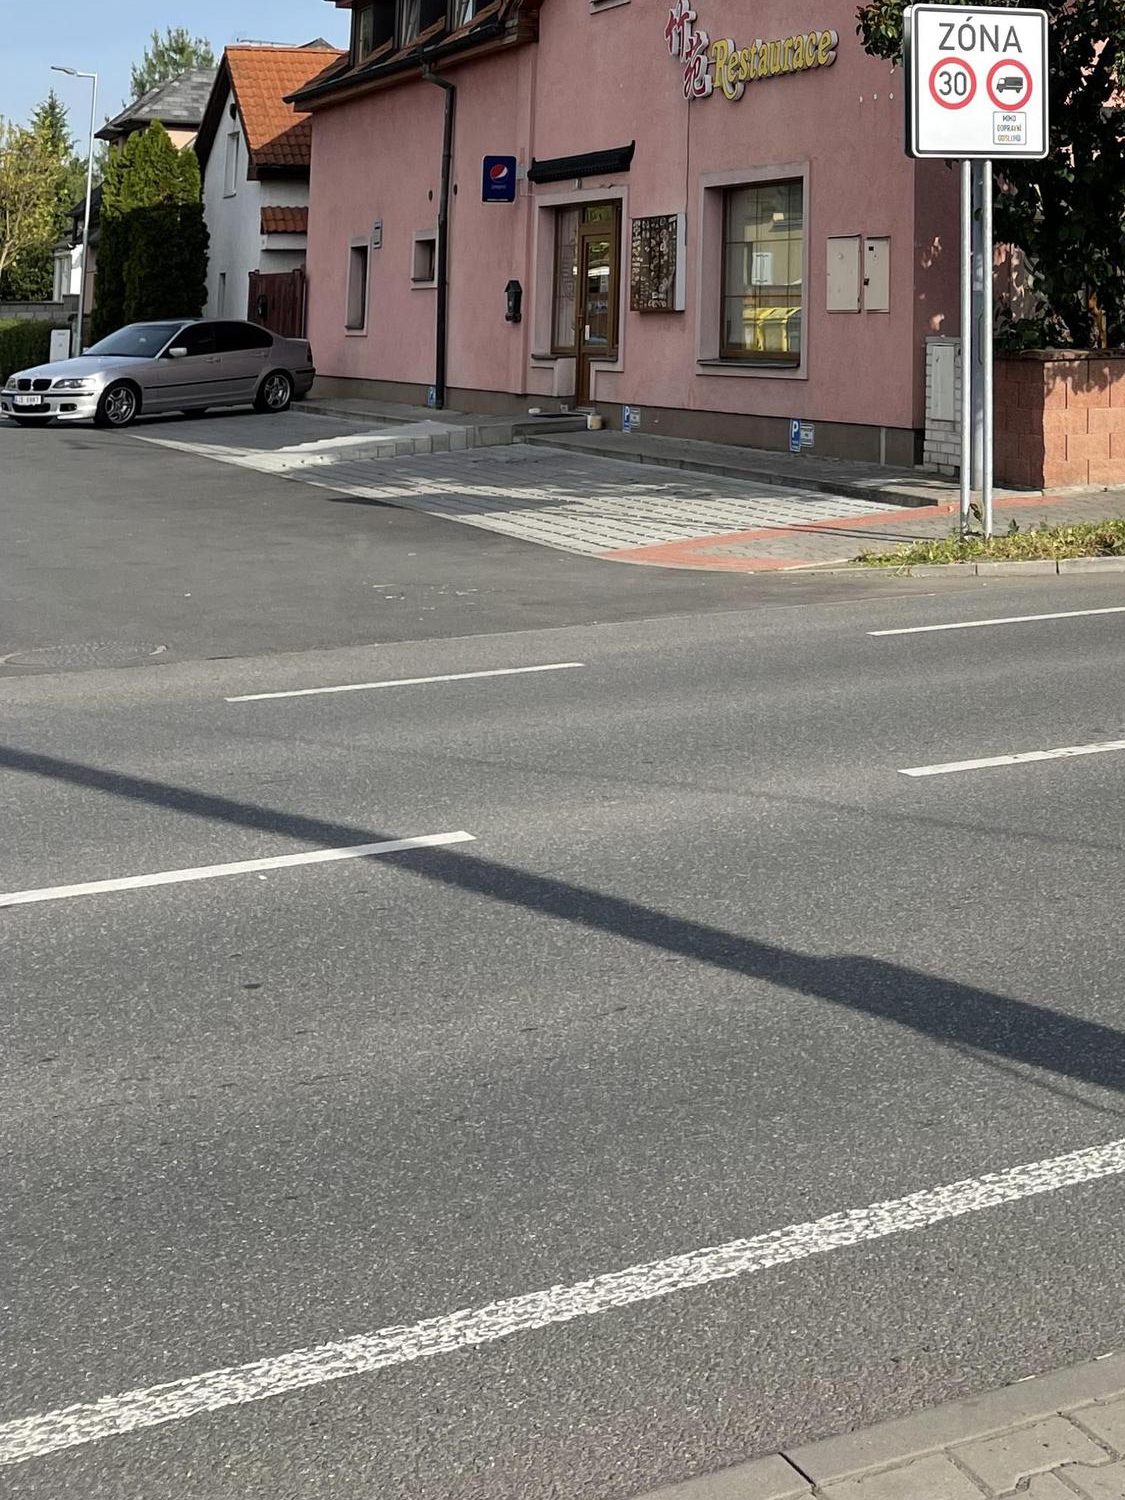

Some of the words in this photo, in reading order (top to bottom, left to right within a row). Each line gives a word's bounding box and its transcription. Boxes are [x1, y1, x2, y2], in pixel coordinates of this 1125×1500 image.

[938, 16, 1023, 53] ZÓNA
[711, 30, 839, 100] Restaurace
[938, 71, 967, 96] 30
[624, 405, 630, 421] P
[792, 420, 799, 438] P
